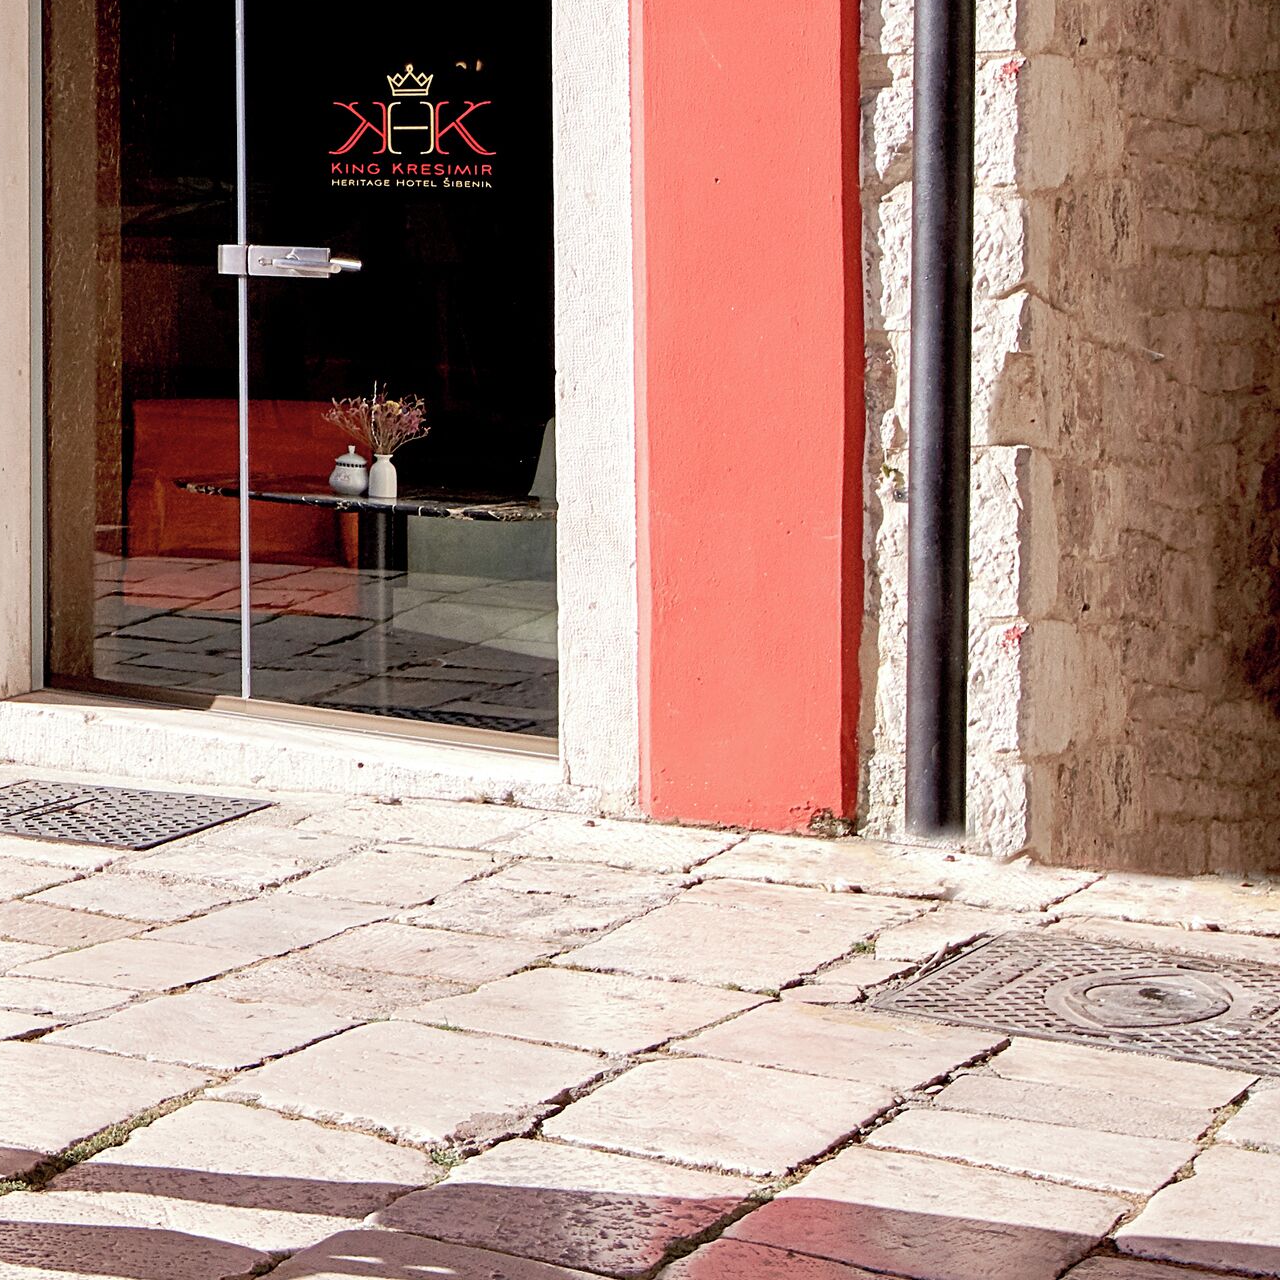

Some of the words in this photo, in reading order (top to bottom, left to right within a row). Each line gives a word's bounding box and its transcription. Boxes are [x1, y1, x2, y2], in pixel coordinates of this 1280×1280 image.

[331, 162, 381, 175] KING
[392, 162, 493, 176] KRESIMIR
[331, 179, 391, 187] HERITAGE
[396, 179, 438, 188] HOTEL
